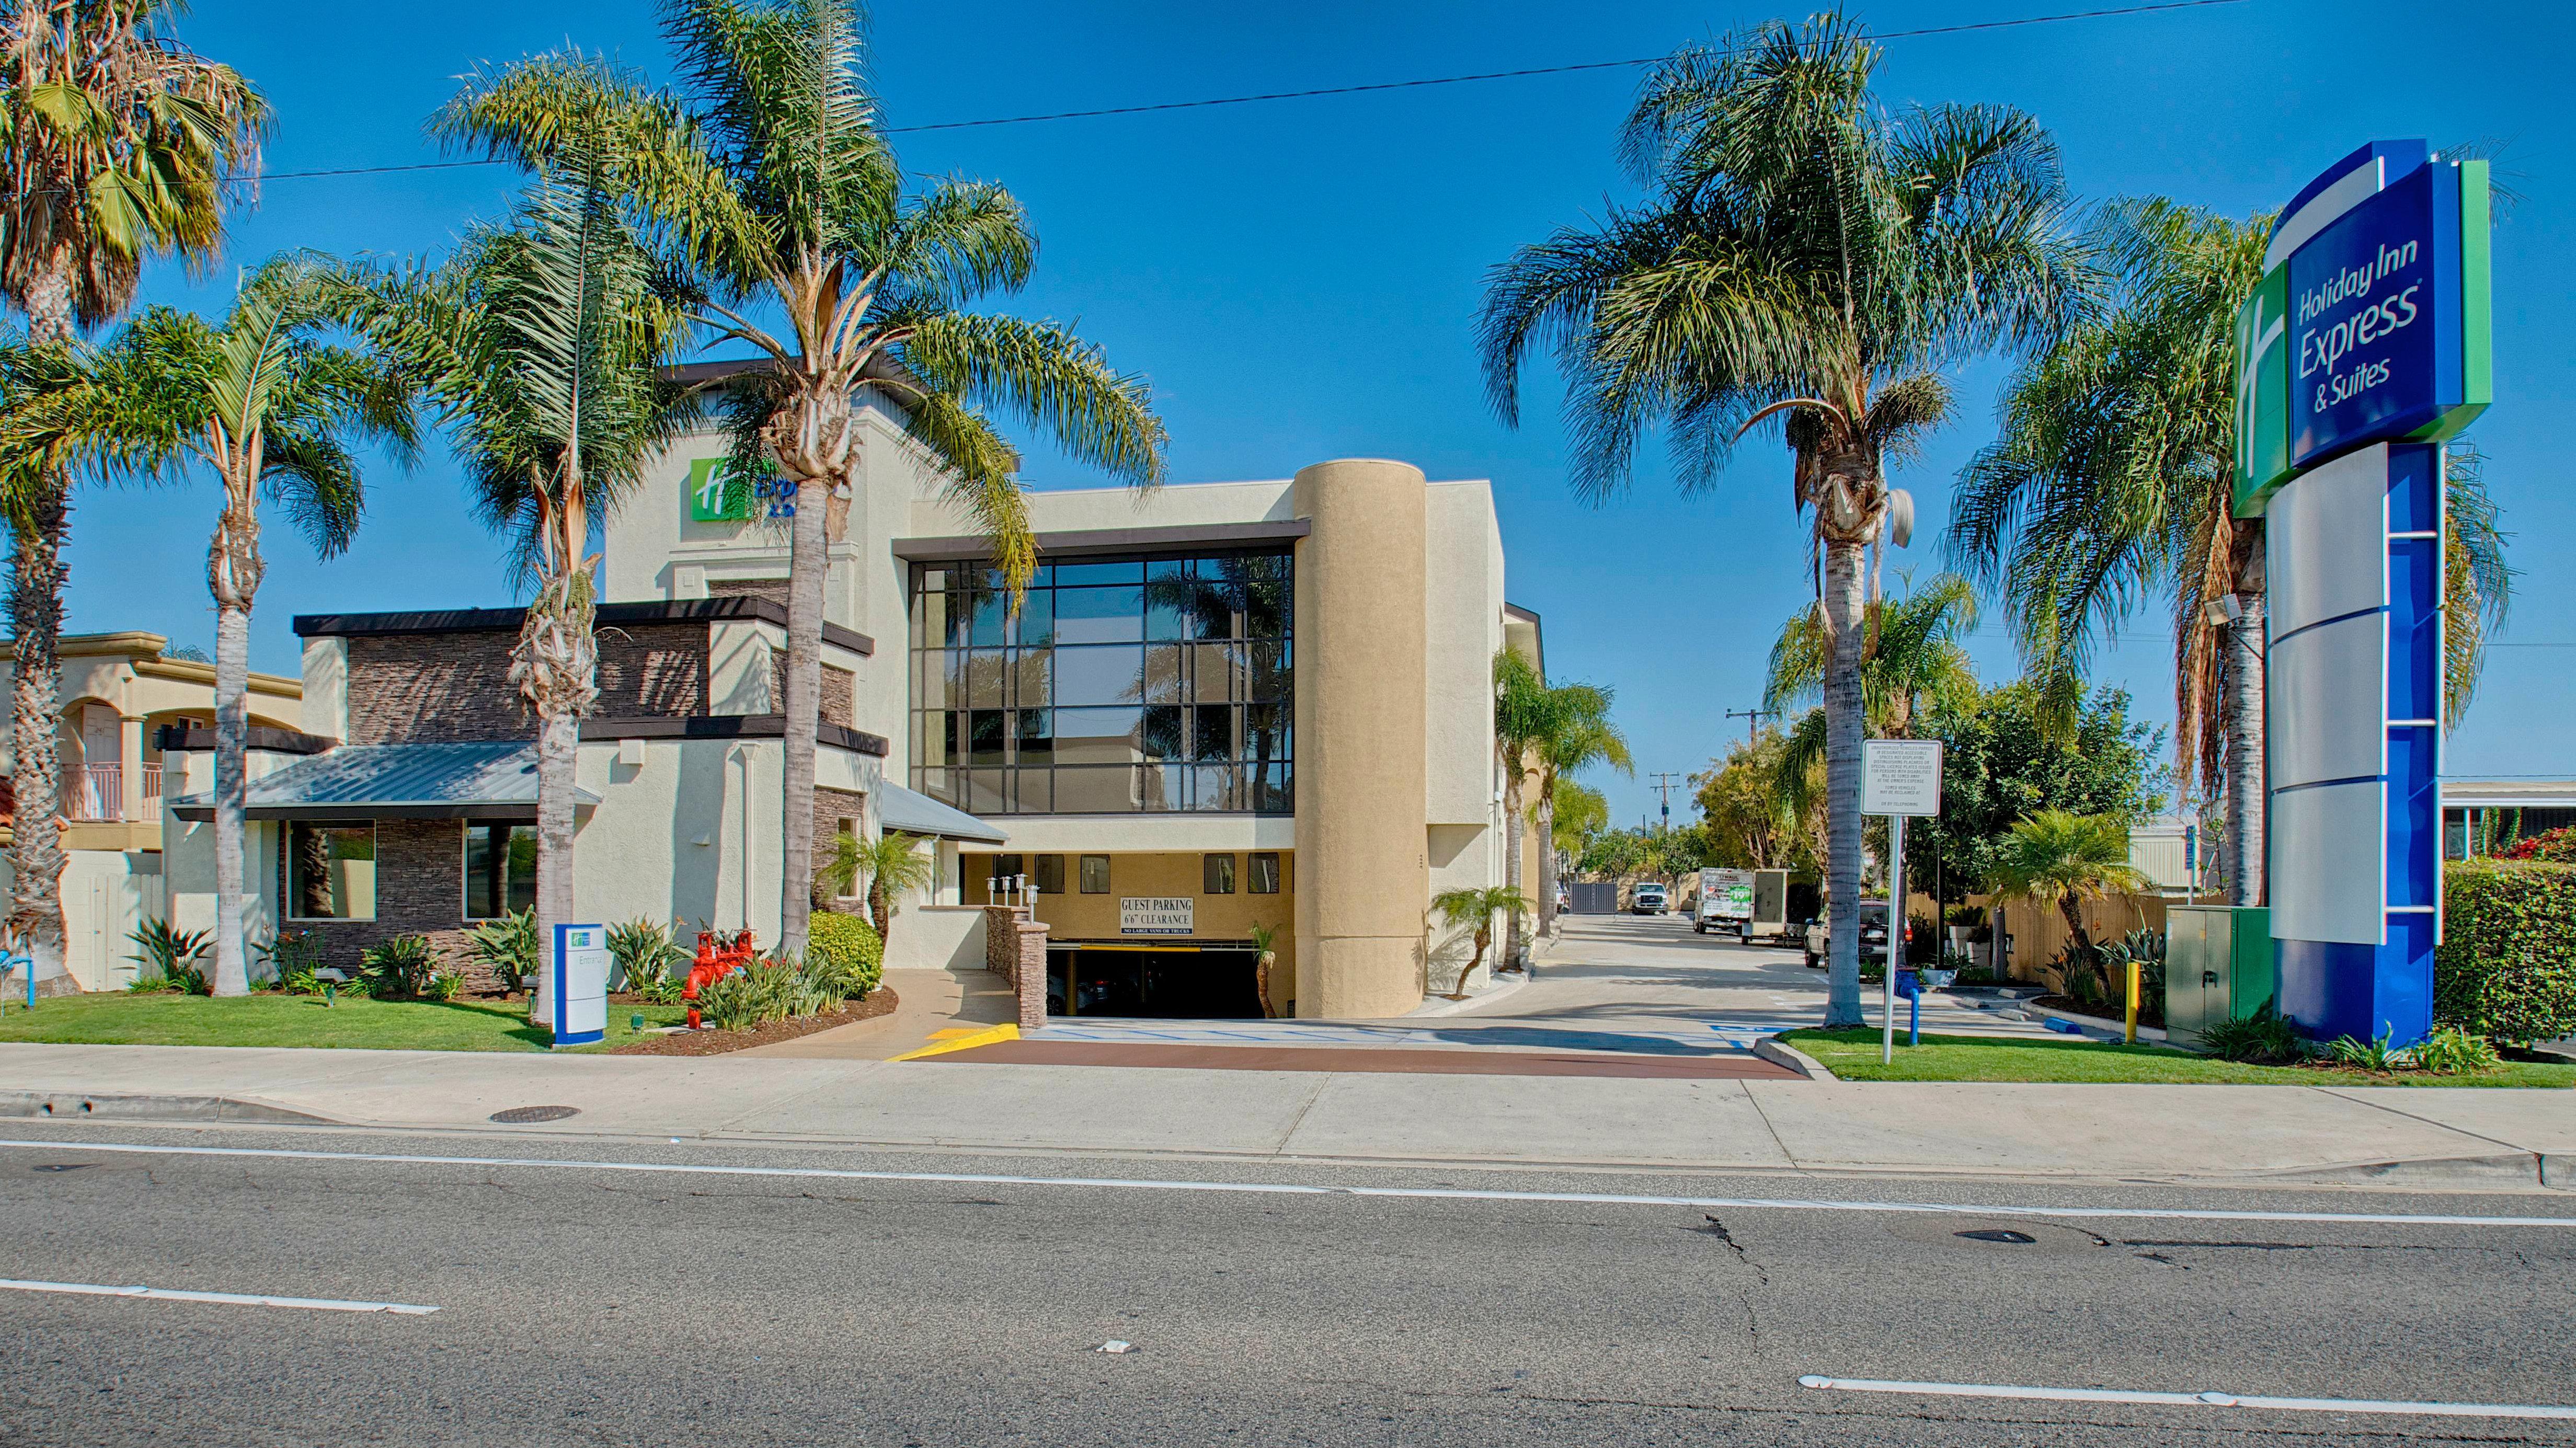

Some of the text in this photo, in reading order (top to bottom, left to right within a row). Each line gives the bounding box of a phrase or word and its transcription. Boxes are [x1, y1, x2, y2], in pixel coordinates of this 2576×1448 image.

[2298, 240, 2418, 326] Holiday Inn
[2298, 285, 2419, 379] Express
[2315, 358, 2390, 413] & Suites
[1122, 899, 1191, 911] GUEST PARKING
[1141, 915, 1188, 924] CLEARANCE
